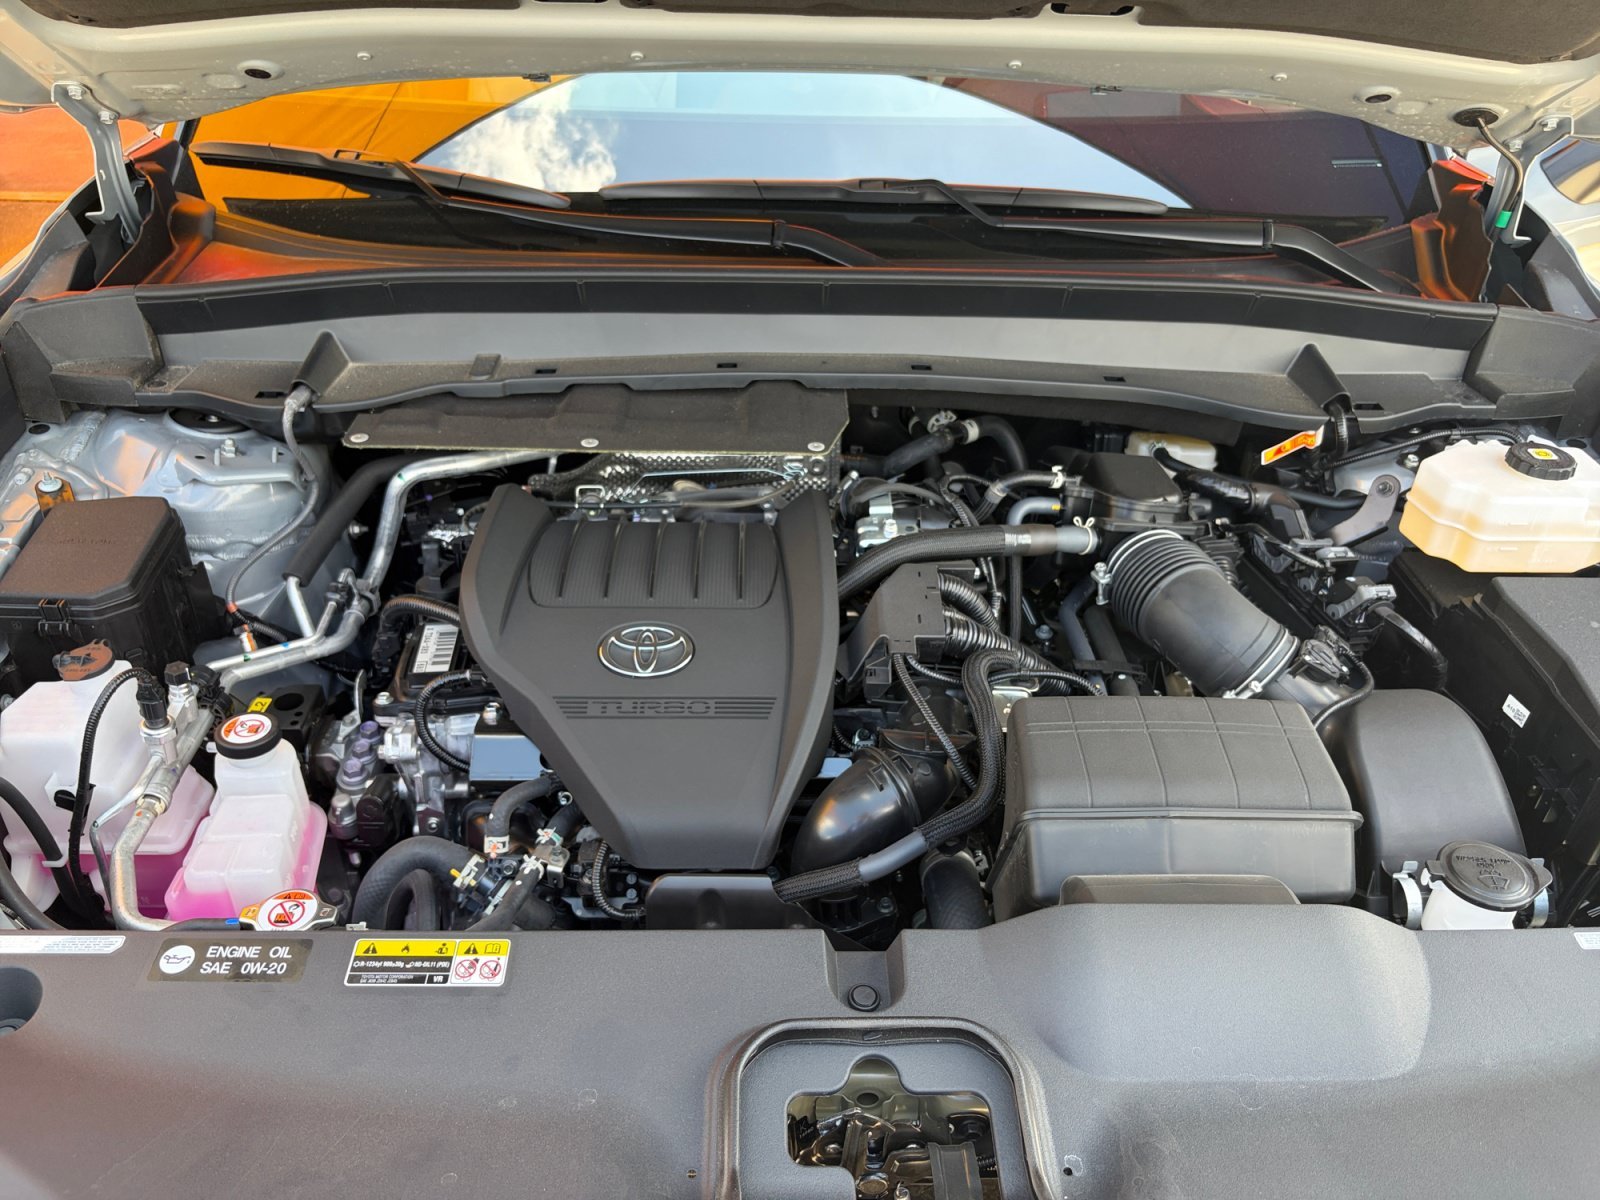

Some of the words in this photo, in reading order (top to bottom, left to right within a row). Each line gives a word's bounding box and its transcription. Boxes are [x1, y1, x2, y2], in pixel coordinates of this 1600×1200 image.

[591, 700, 712, 715] TURBO
[205, 945, 262, 958] ENGINE
[269, 945, 293, 958] OIL
[199, 961, 233, 974] SAE
[240, 961, 288, 974] 0W-20
